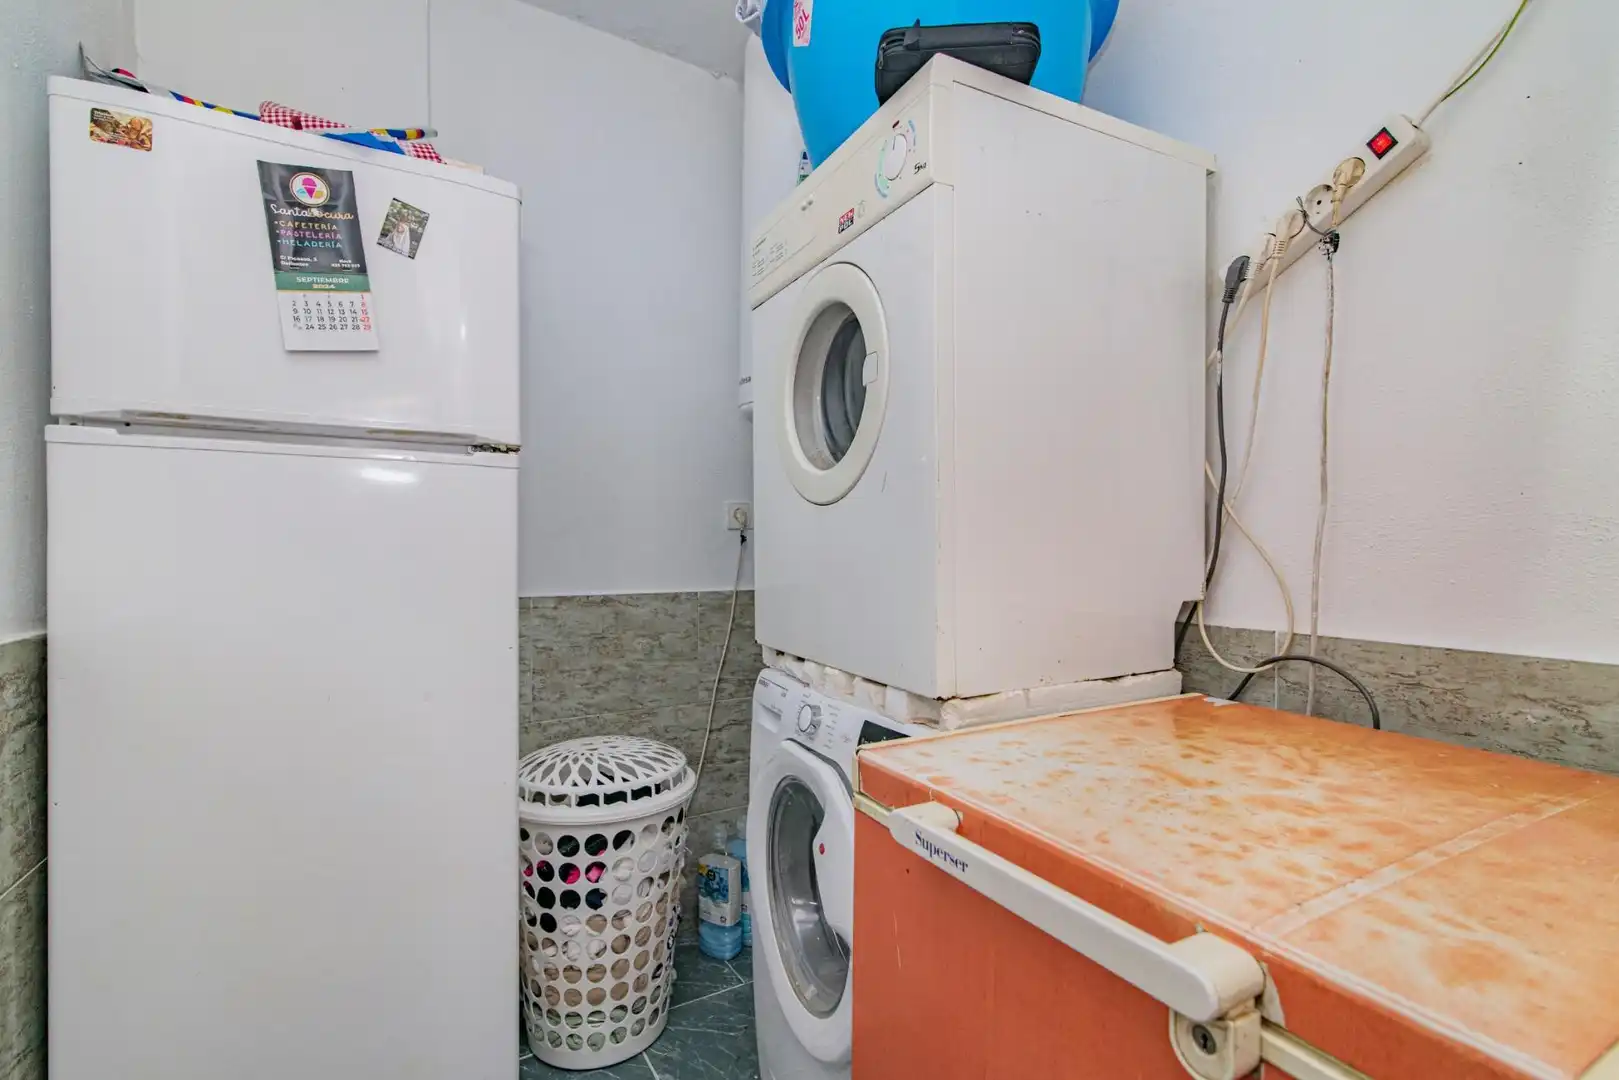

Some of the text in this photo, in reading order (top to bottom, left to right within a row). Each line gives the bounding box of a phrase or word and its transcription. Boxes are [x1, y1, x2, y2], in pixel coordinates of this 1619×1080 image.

[279, 220, 338, 230] CAFETERÍA
[840, 220, 853, 233] POL
[280, 230, 342, 240] PASTELERÍA
[283, 239, 342, 248] HELADERÍA
[914, 829, 968, 874] Superser
